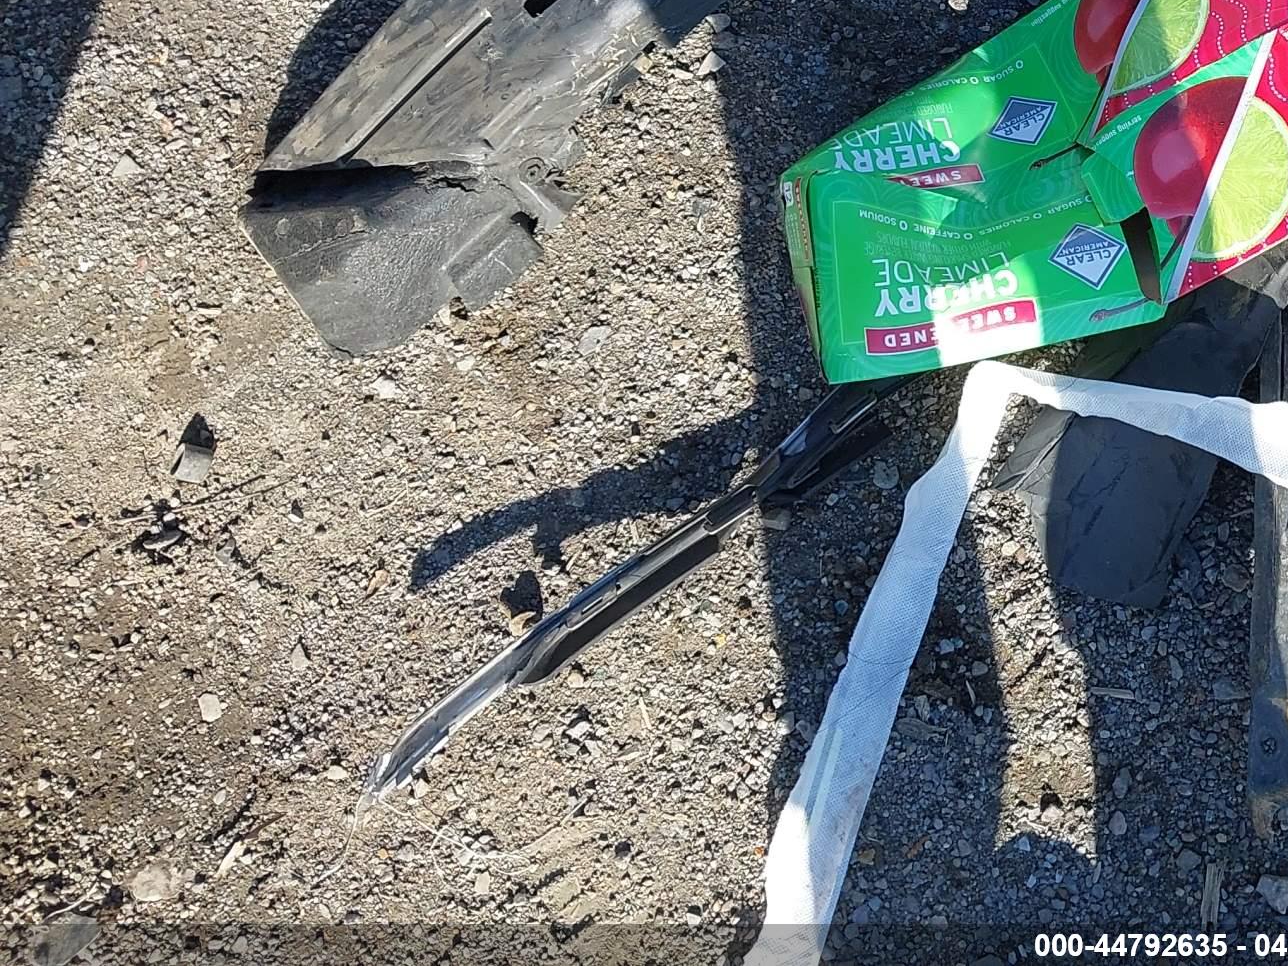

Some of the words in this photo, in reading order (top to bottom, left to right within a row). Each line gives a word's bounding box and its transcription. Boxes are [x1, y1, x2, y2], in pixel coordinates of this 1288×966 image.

[984, 65, 1014, 82] SUGAR
[919, 78, 968, 91] CALORIES
[996, 106, 1042, 132] AMERICAN
[1004, 114, 1046, 136] CLEAR
[1116, 114, 1142, 132] serving
[834, 140, 960, 172] CHERRY
[1048, 198, 1083, 214] SUGAR
[860, 210, 896, 226] SODIUM
[980, 215, 1030, 236] CALORIES
[914, 223, 961, 240] CAFFEINE
[1062, 241, 1109, 254] AMERICAN
[1066, 249, 1112, 266] CLEAR
[872, 252, 1010, 287] LIMEADE
[874, 270, 1018, 318] CHERRY
